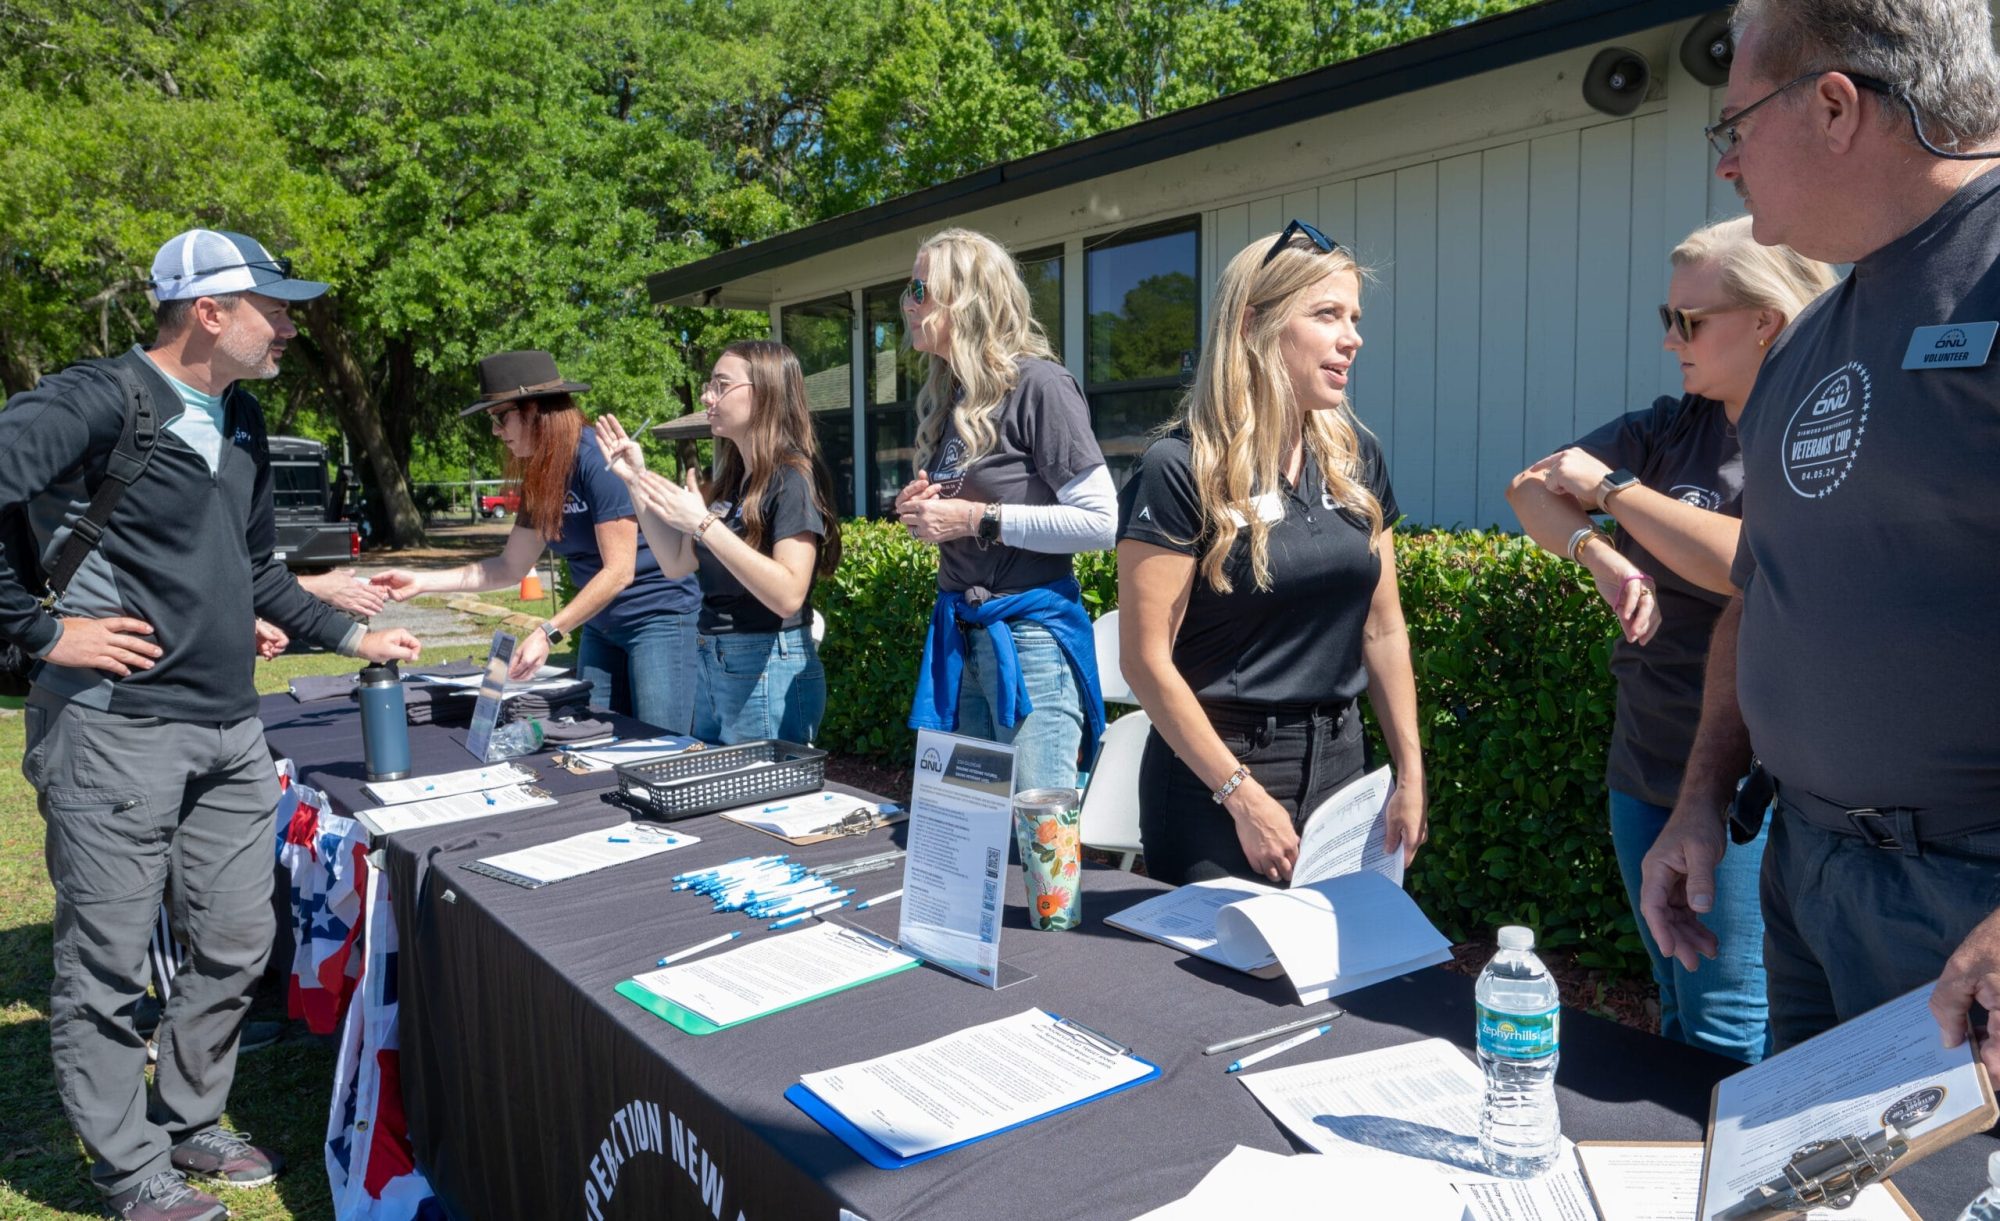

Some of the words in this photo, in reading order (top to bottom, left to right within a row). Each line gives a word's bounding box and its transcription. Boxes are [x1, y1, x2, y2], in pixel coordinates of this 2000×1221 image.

[1935, 339, 1968, 349] ONU
[1923, 351, 1969, 362] VOLUNTEER
[1812, 390, 1851, 416] ONU
[1834, 428, 1851, 453] CUP
[1801, 467, 1835, 481] 04.05.24
[920, 759, 943, 773] ONU
[1482, 1021, 1538, 1041] Zephyrhills
[585, 1099, 663, 1221] PERATION
[669, 1110, 724, 1220] NEW
